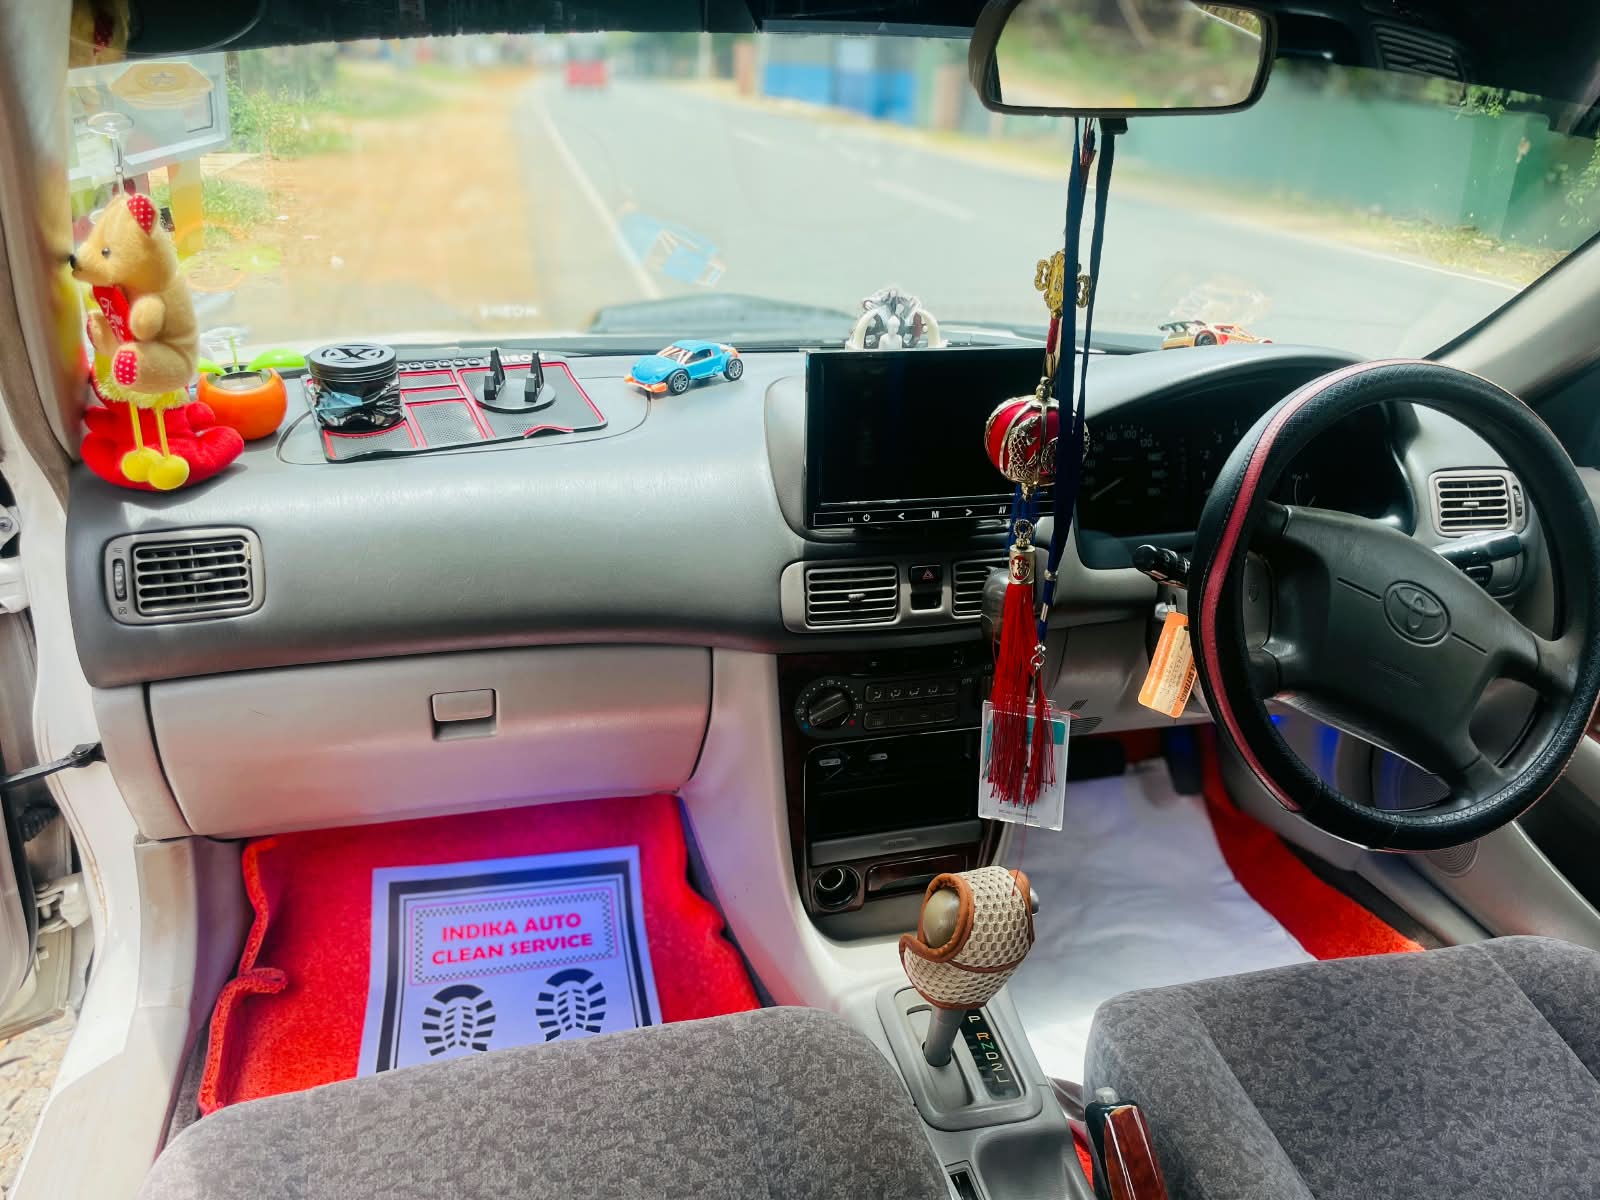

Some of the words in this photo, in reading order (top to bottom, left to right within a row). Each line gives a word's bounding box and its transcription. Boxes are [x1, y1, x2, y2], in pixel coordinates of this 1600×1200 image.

[931, 510, 940, 519] M
[998, 505, 1007, 515] AV
[442, 920, 518, 942] INDIKA
[524, 912, 582, 932] AUTO
[431, 944, 504, 965] CLEAN
[510, 933, 593, 956] SERVICE
[968, 1015, 981, 1023] P
[976, 1032, 990, 1040] R
[981, 1042, 995, 1050] N
[986, 1052, 999, 1060] D
